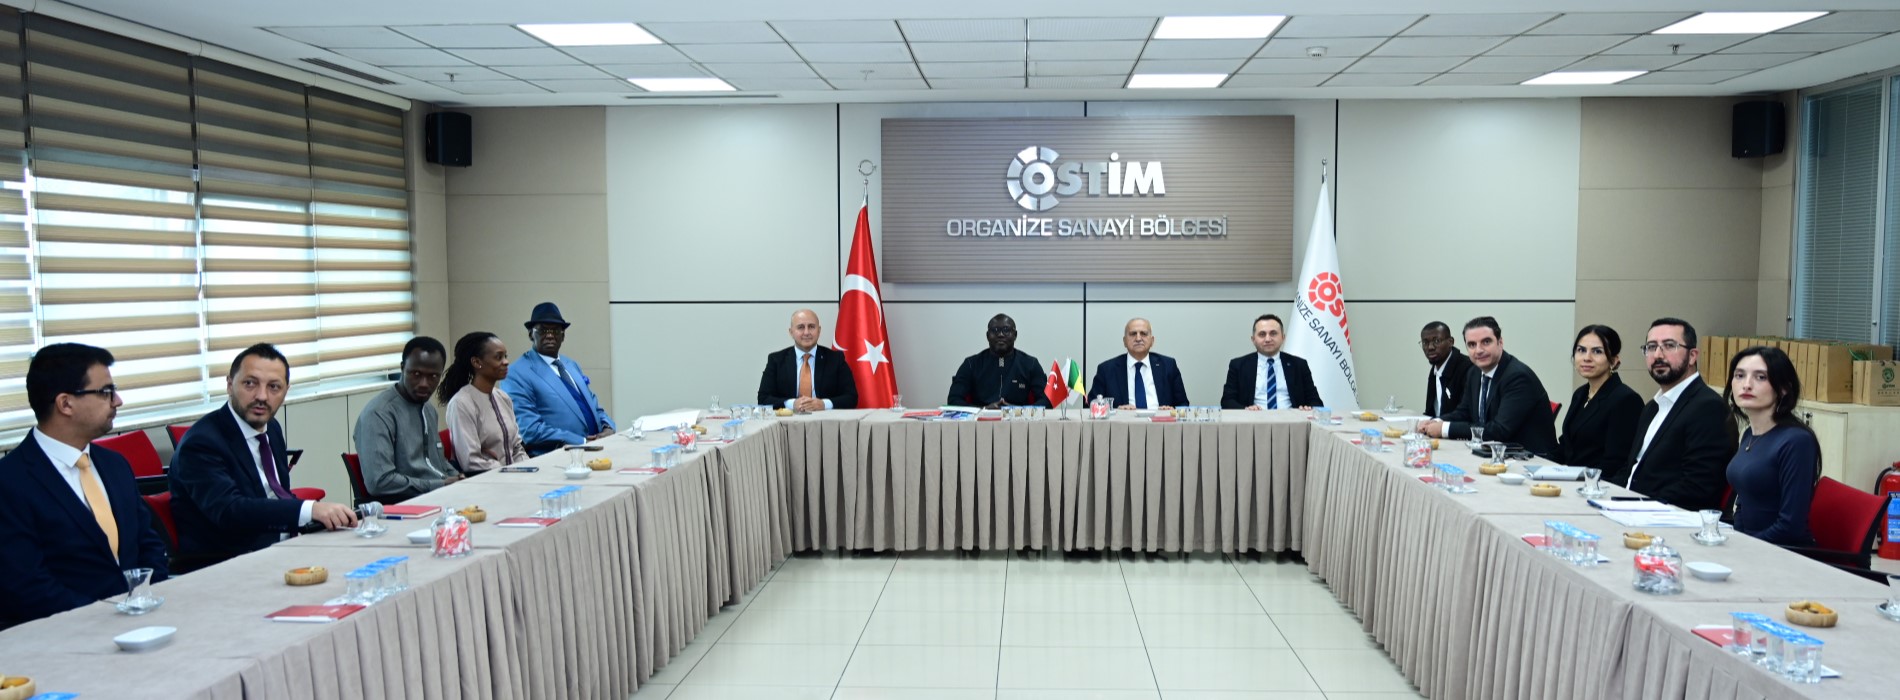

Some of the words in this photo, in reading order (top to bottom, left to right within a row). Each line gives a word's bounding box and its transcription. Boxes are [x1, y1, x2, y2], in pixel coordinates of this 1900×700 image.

[1007, 146, 1166, 211] OSTİM
[947, 214, 1053, 237] ORGANİZE
[1058, 214, 1135, 237] SANAYİ
[1140, 214, 1228, 237] BÖLGESİ
